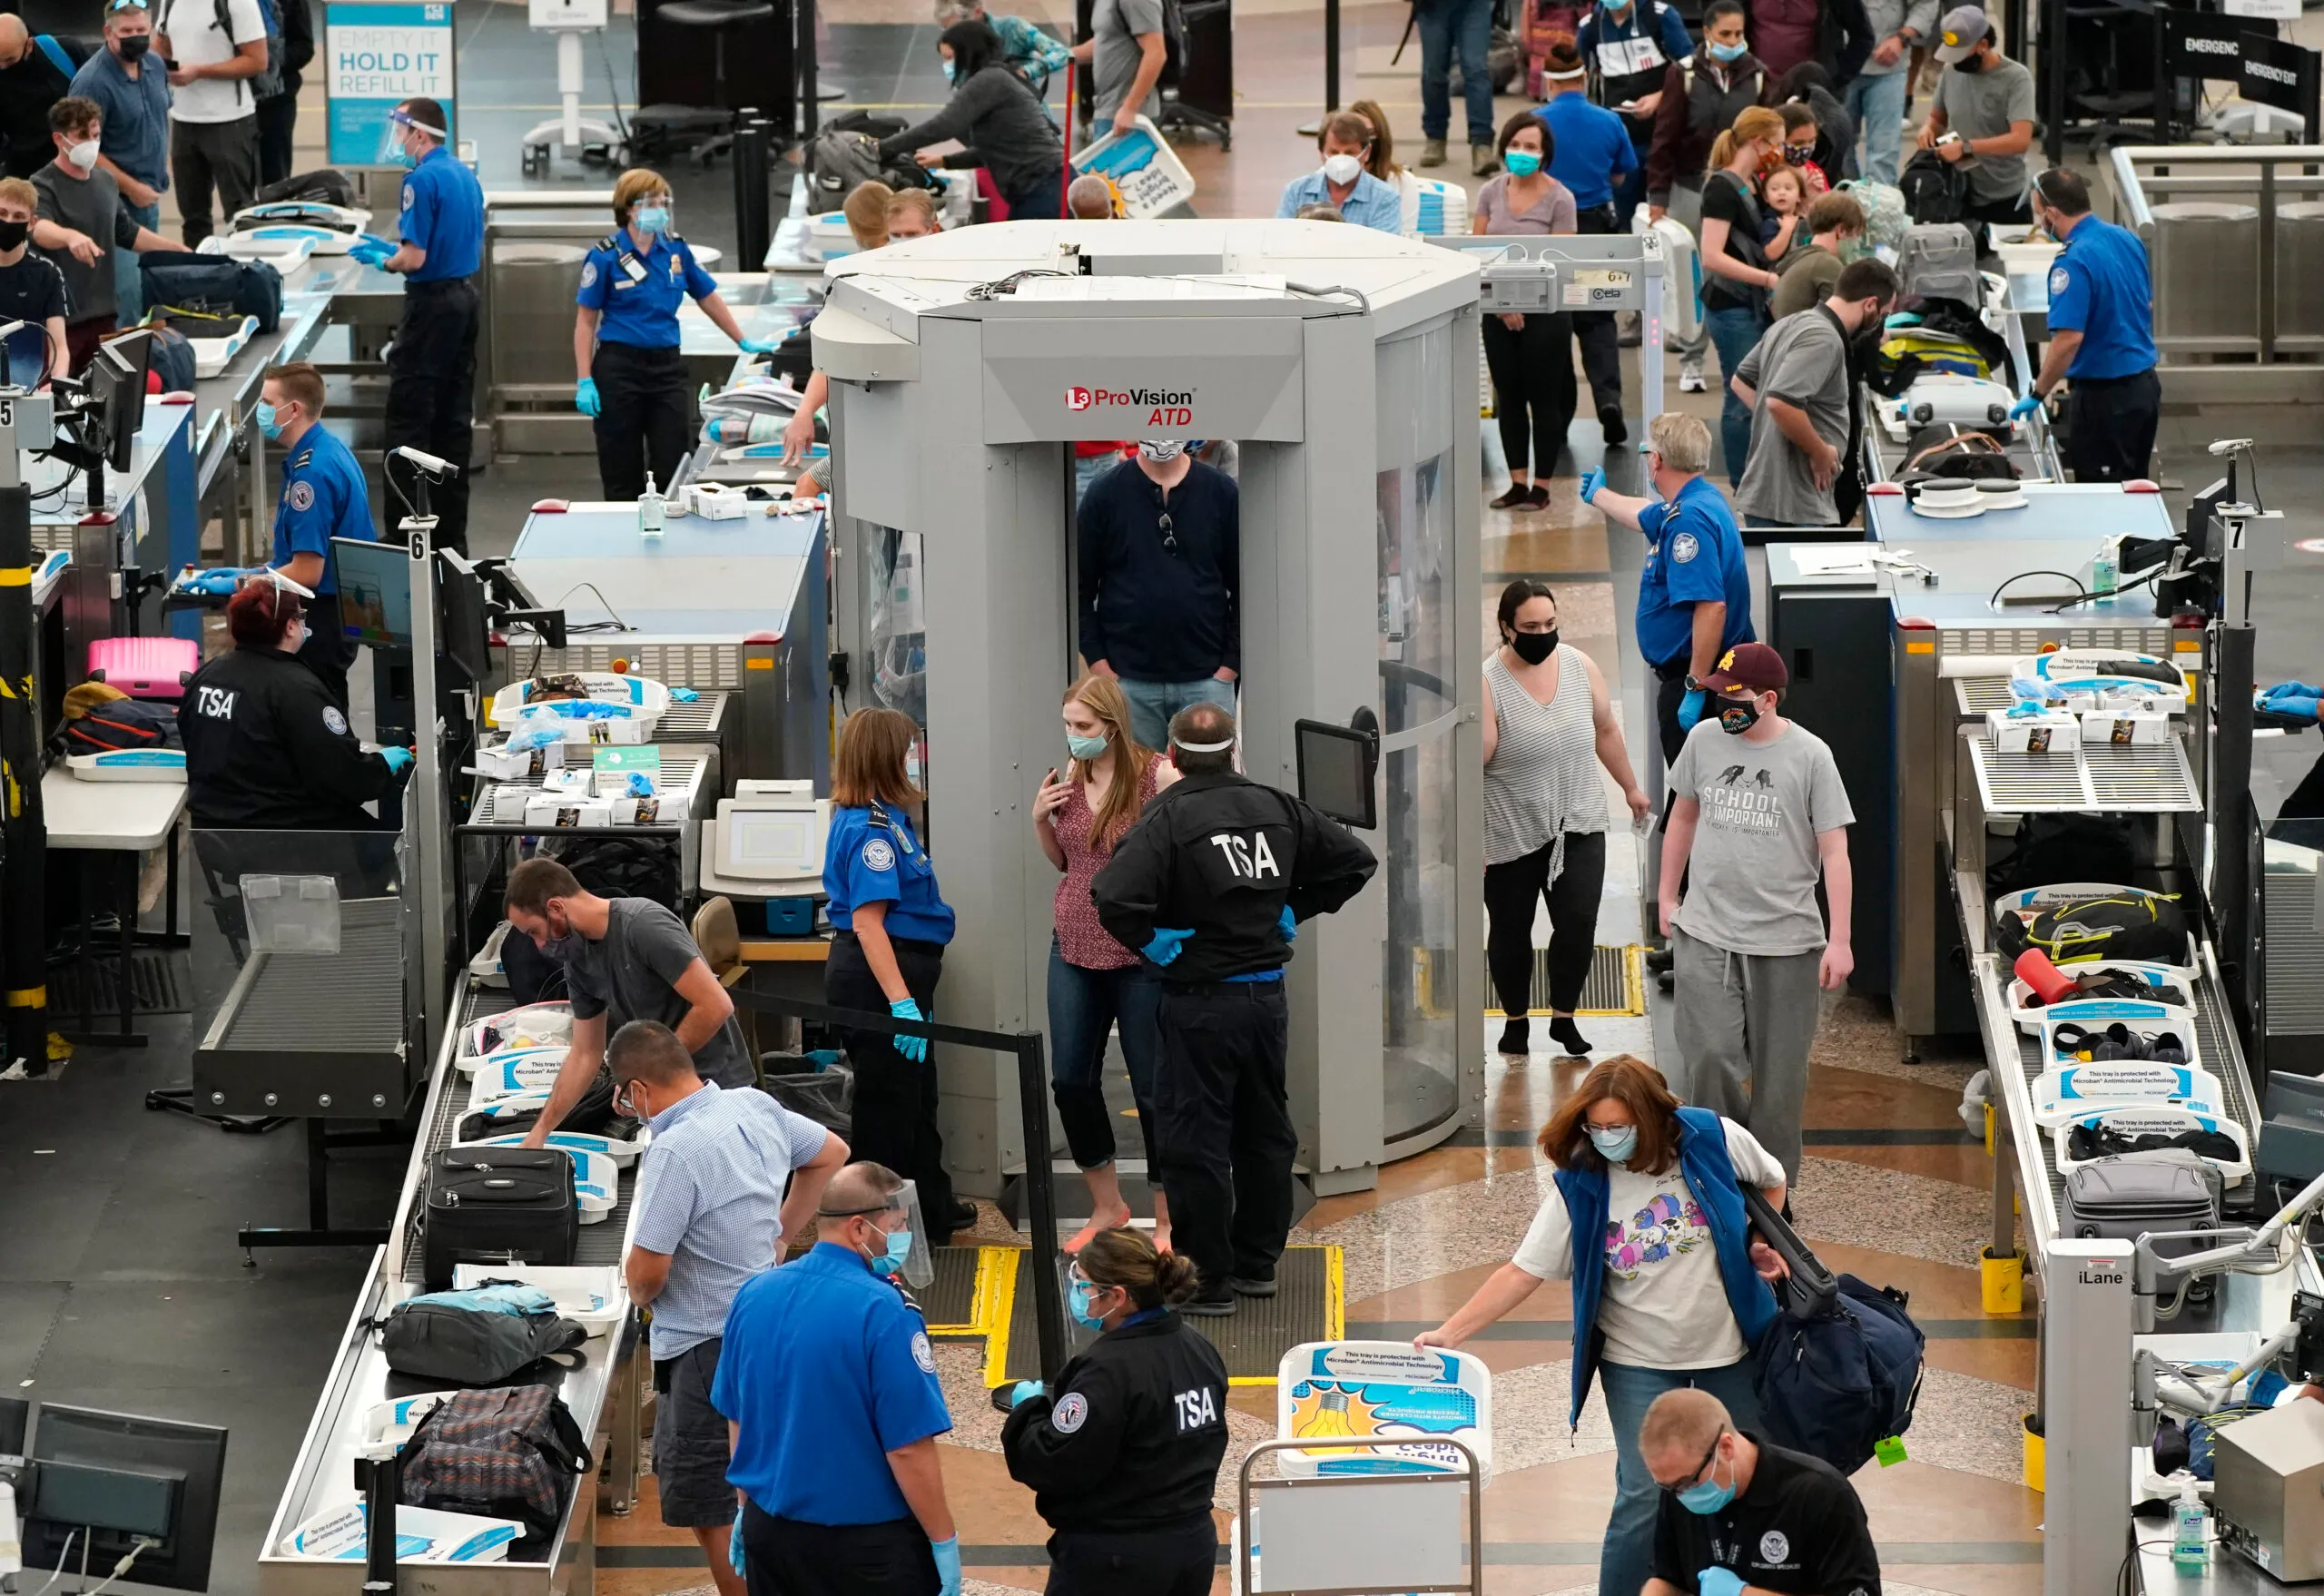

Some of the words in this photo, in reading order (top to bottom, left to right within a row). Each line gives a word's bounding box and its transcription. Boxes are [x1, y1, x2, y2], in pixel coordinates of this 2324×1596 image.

[338, 30, 413, 48] EMPTY
[420, 31, 438, 49] IT
[2185, 37, 2240, 55] EMERGENC
[340, 52, 409, 72] HOLD
[418, 53, 439, 72] IT
[2245, 60, 2282, 82] EMERGENCY
[2281, 72, 2297, 85] EXIT
[340, 75, 415, 93] REFILL
[421, 76, 439, 94] IT
[1150, 182, 1178, 207] Need
[0, 400, 12, 426] 5
[1147, 409, 1192, 426] ATD
[411, 533, 424, 560] 6
[2230, 521, 2243, 548] 7
[198, 685, 234, 720] TSA
[1704, 786, 1781, 814] SCHOOL
[1714, 805, 1782, 828] IMPORTANT
[1210, 832, 1280, 879] TSA
[2079, 1271, 2123, 1284] iLane
[1361, 1359, 1404, 1367] Antimicrobial
[1406, 1362, 1443, 1370] Technology
[1174, 1387, 1217, 1430] TSA
